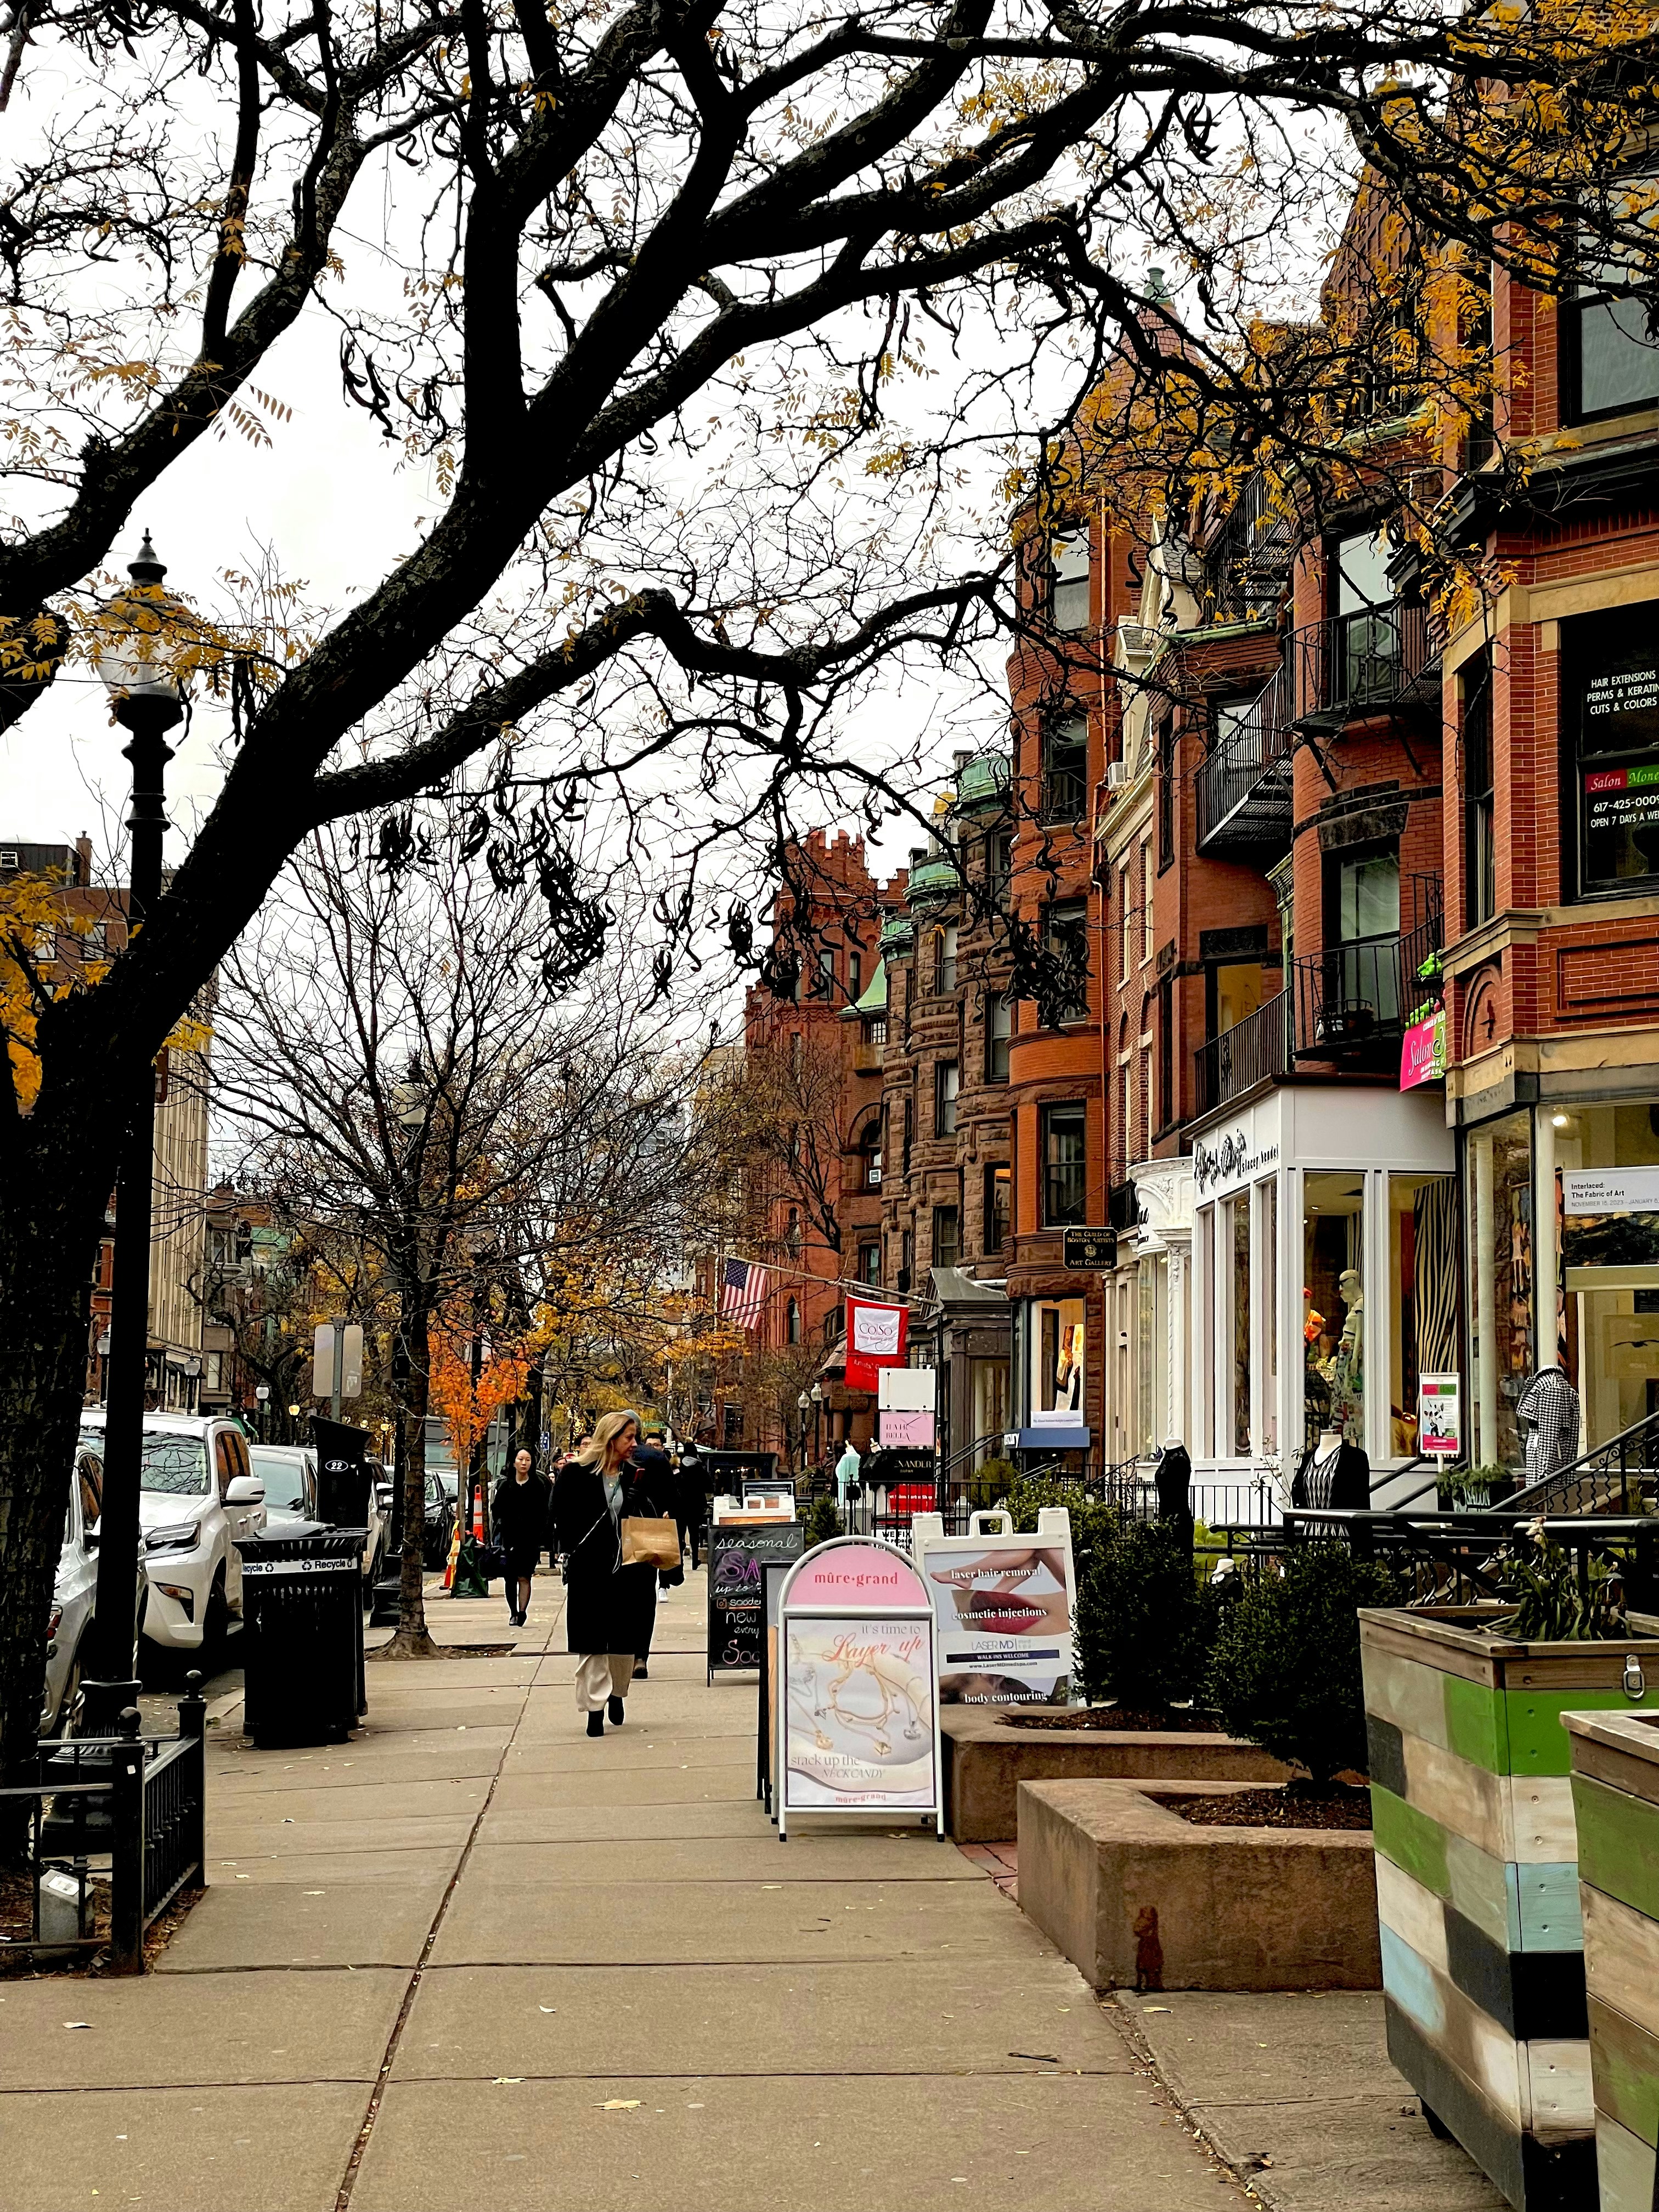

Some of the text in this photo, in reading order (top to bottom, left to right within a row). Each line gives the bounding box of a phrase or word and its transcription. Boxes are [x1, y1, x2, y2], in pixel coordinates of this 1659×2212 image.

[1591, 670, 1656, 689] HAIR EXTENSIONS
[1587, 690, 1614, 702] PERMS
[1617, 688, 1624, 698] &
[1590, 696, 1657, 715] CUTS & COLORS
[1590, 774, 1621, 790] Salon
[1590, 817, 1609, 828] OPEN
[1611, 816, 1617, 825] 7
[1620, 813, 1637, 824] DAYS
[1639, 812, 1645, 821] A
[330, 1462, 342, 1470] 22
[714, 1533, 798, 1550] seasonal
[314, 1559, 346, 1570] Recycle
[951, 1566, 1041, 1579] laser hair removal
[715, 1585, 733, 1595] up
[735, 1584, 754, 1592] to
[726, 1611, 757, 1624] new
[952, 1607, 1047, 1621] cosmetic injections
[734, 1626, 759, 1639] every
[882, 1624, 907, 1634] time
[910, 1626, 921, 1634] to
[821, 1632, 926, 1668] Layer up
[972, 1640, 998, 1651] LASER
[999, 1639, 1014, 1650] MD
[964, 1690, 1048, 1704] body contouring
[791, 1753, 860, 1769] stack up the
